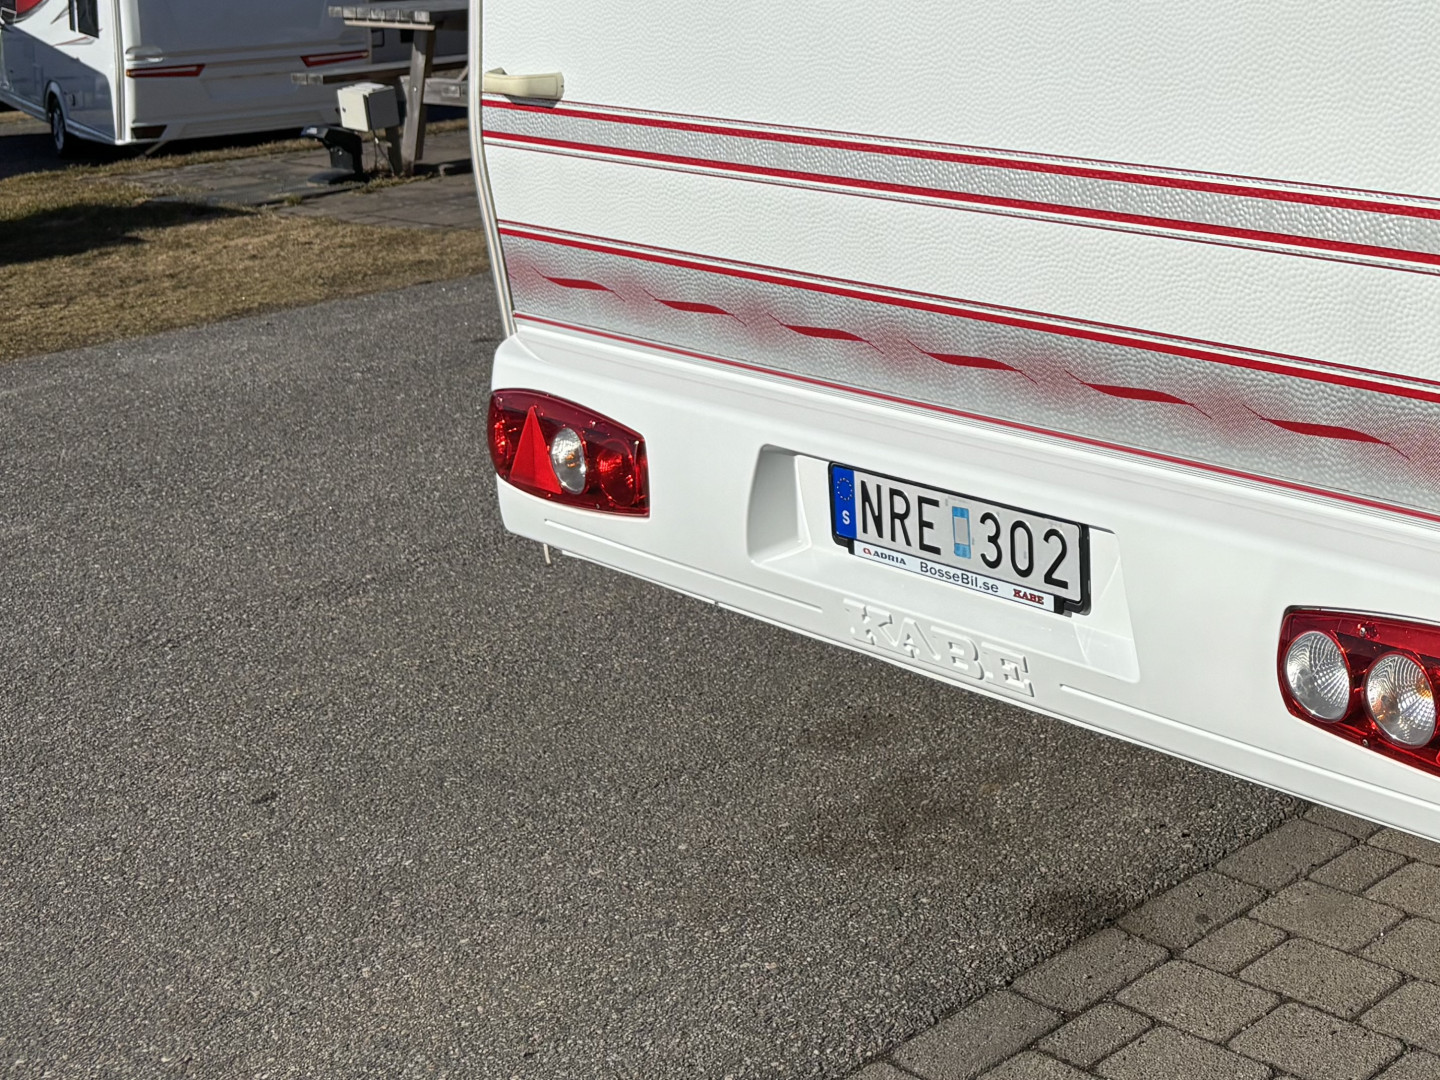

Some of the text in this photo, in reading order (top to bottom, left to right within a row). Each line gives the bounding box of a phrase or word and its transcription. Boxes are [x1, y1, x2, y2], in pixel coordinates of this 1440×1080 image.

[842, 510, 851, 525] S
[860, 479, 1069, 589] NRE 302
[873, 550, 907, 565] ADRIA
[919, 561, 999, 592] BosseBil.se
[1013, 589, 1044, 605] KABE
[844, 601, 1035, 697] KABE
